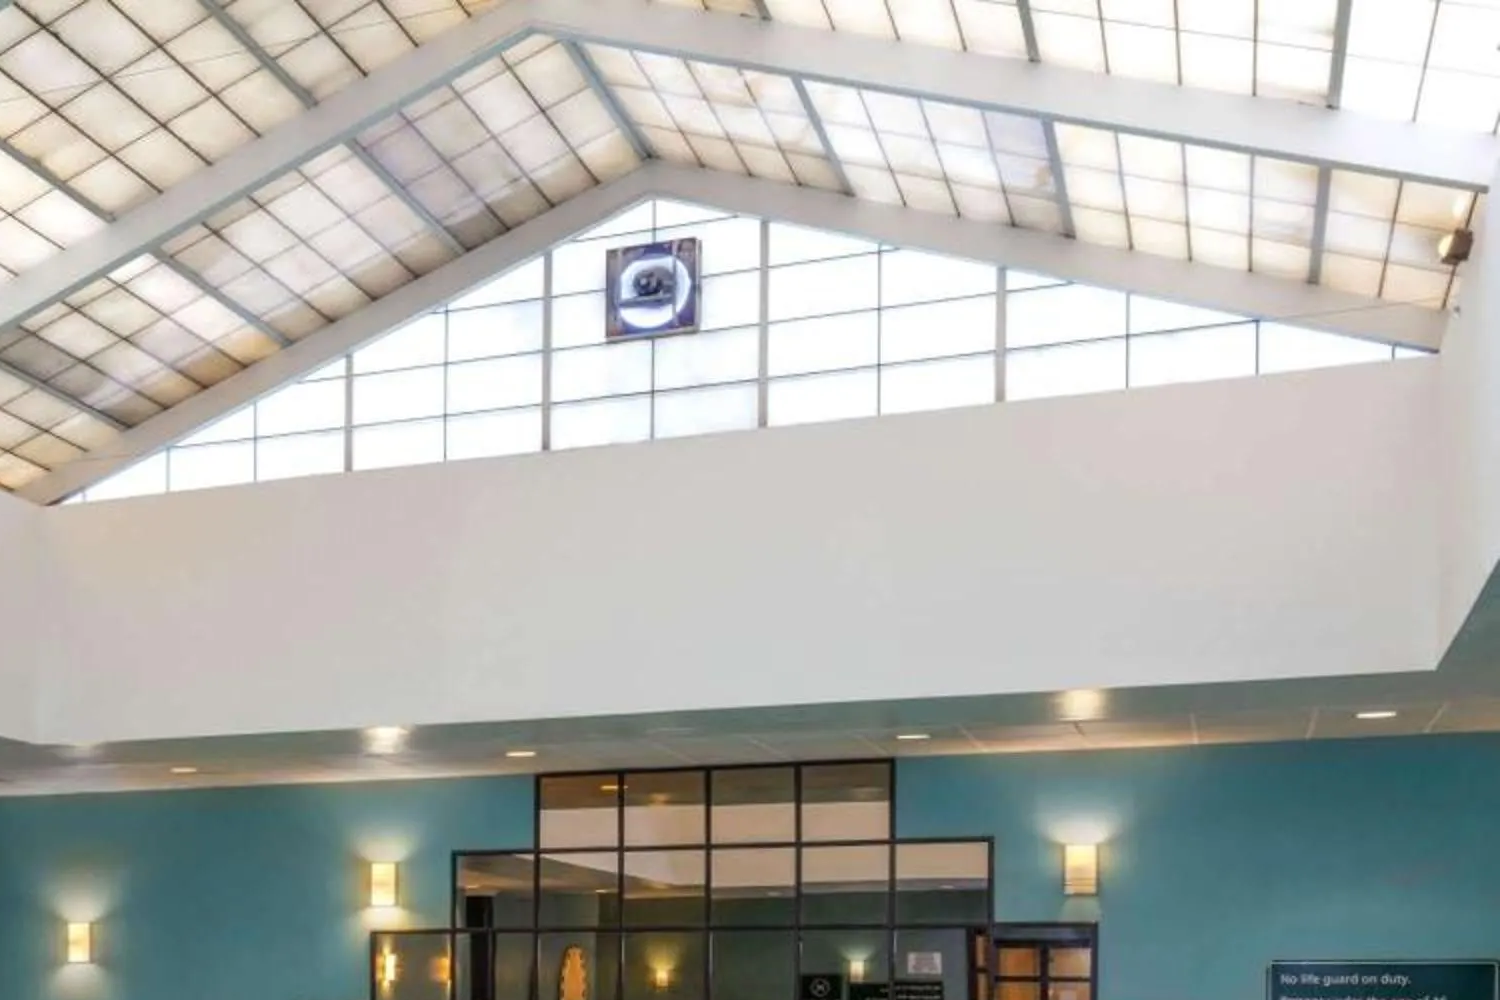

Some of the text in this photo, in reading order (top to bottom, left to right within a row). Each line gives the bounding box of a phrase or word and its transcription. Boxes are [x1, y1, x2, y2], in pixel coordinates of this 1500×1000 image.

[1280, 973, 1411, 986] No life guard on duty.
